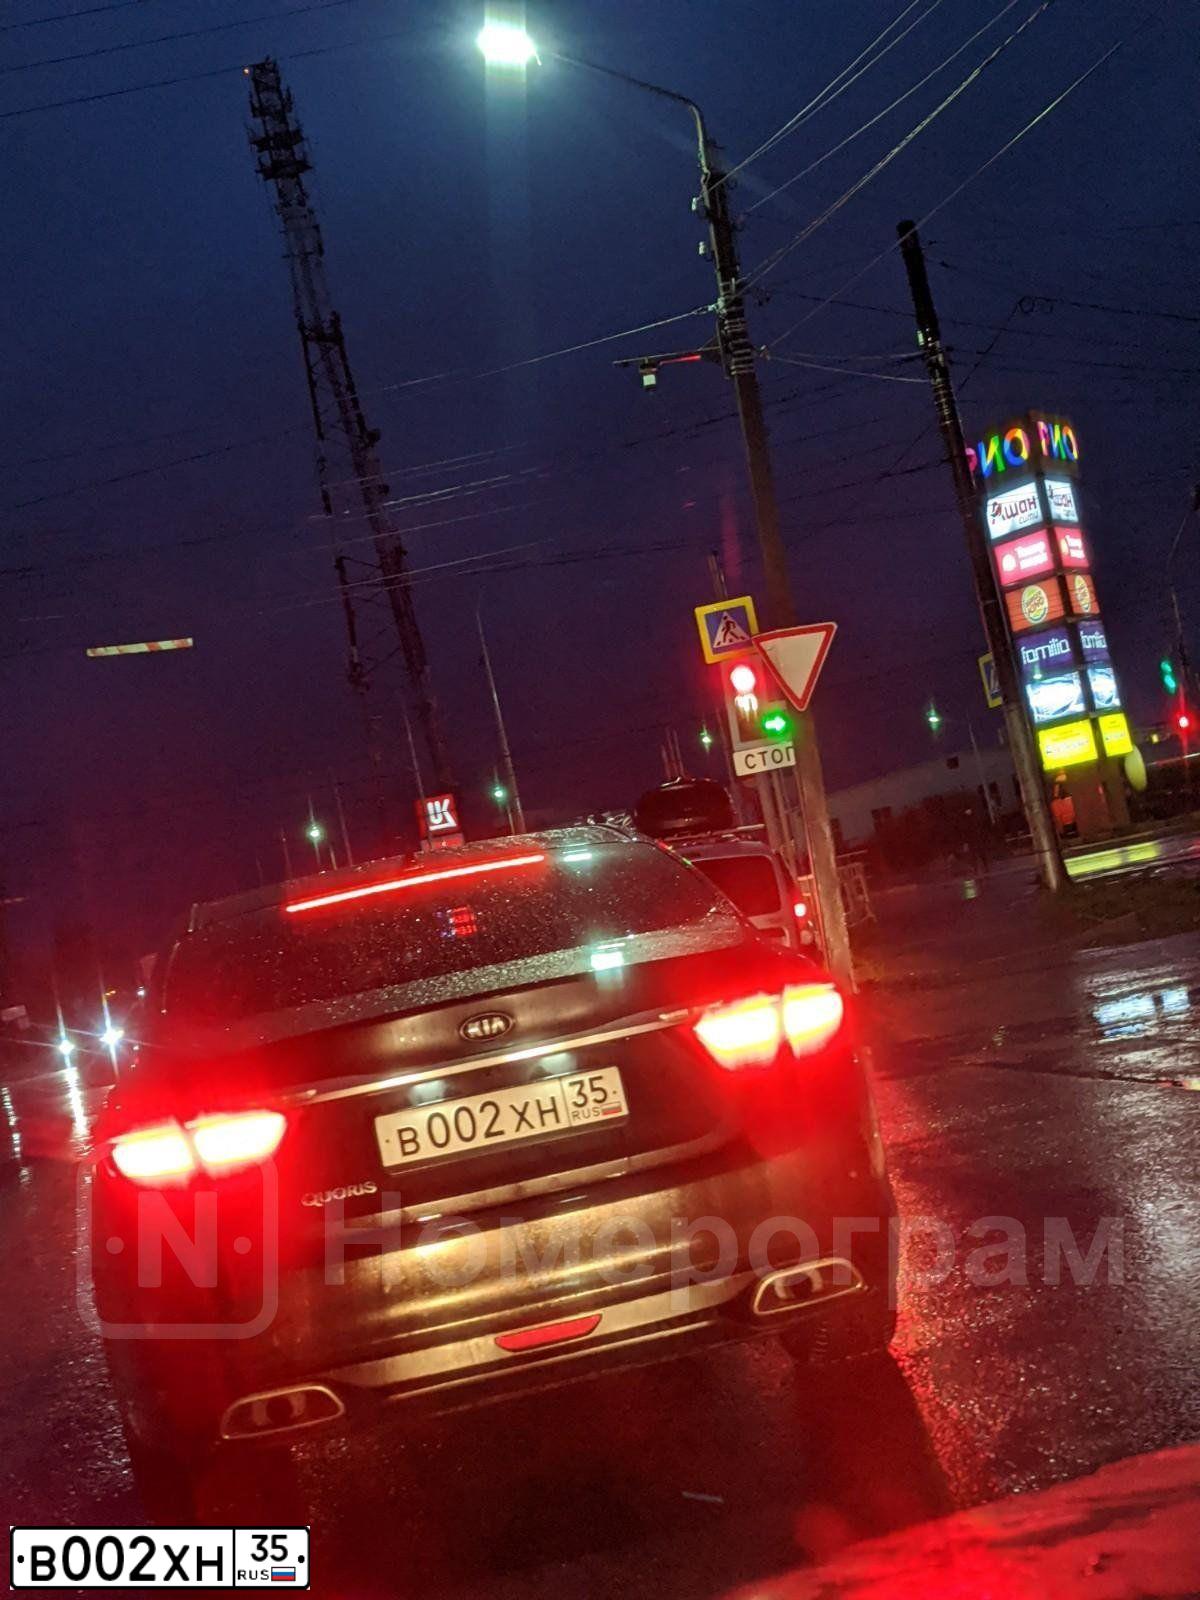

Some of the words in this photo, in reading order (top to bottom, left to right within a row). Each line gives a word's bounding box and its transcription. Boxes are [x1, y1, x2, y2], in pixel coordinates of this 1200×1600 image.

[1037, 421, 1079, 461] РИО
[464, 1018, 507, 1039] KIA
[568, 1076, 608, 1108] 35
[571, 1106, 601, 1121] RUS
